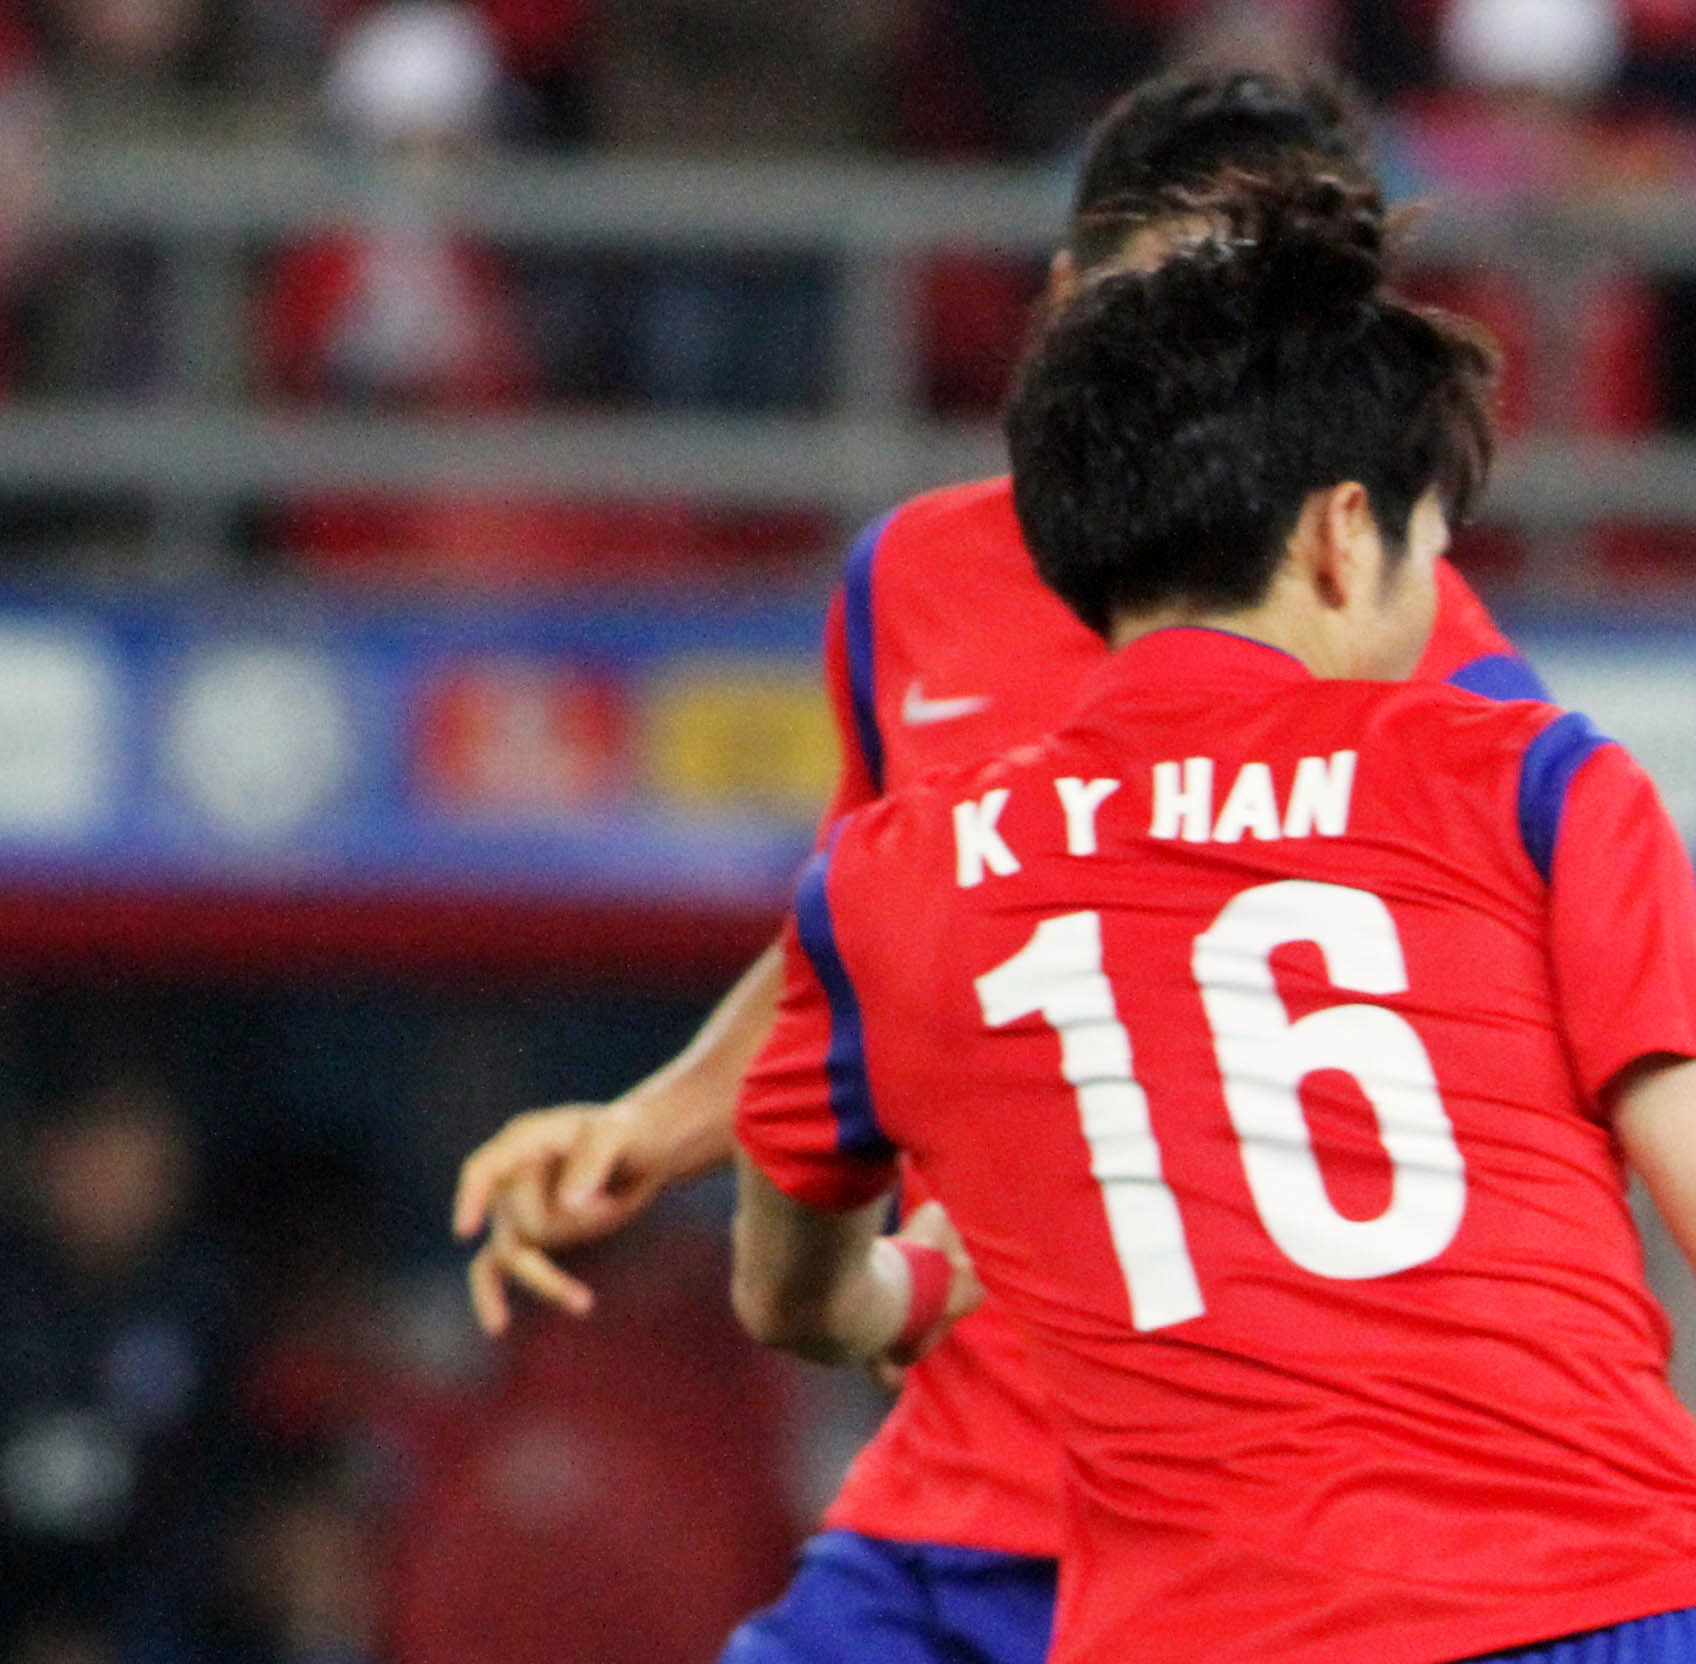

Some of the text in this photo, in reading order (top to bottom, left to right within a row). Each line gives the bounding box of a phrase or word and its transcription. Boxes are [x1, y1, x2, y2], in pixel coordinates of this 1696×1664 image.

[953, 750, 1357, 888] K Y HAN
[974, 879, 1468, 1333] 16
